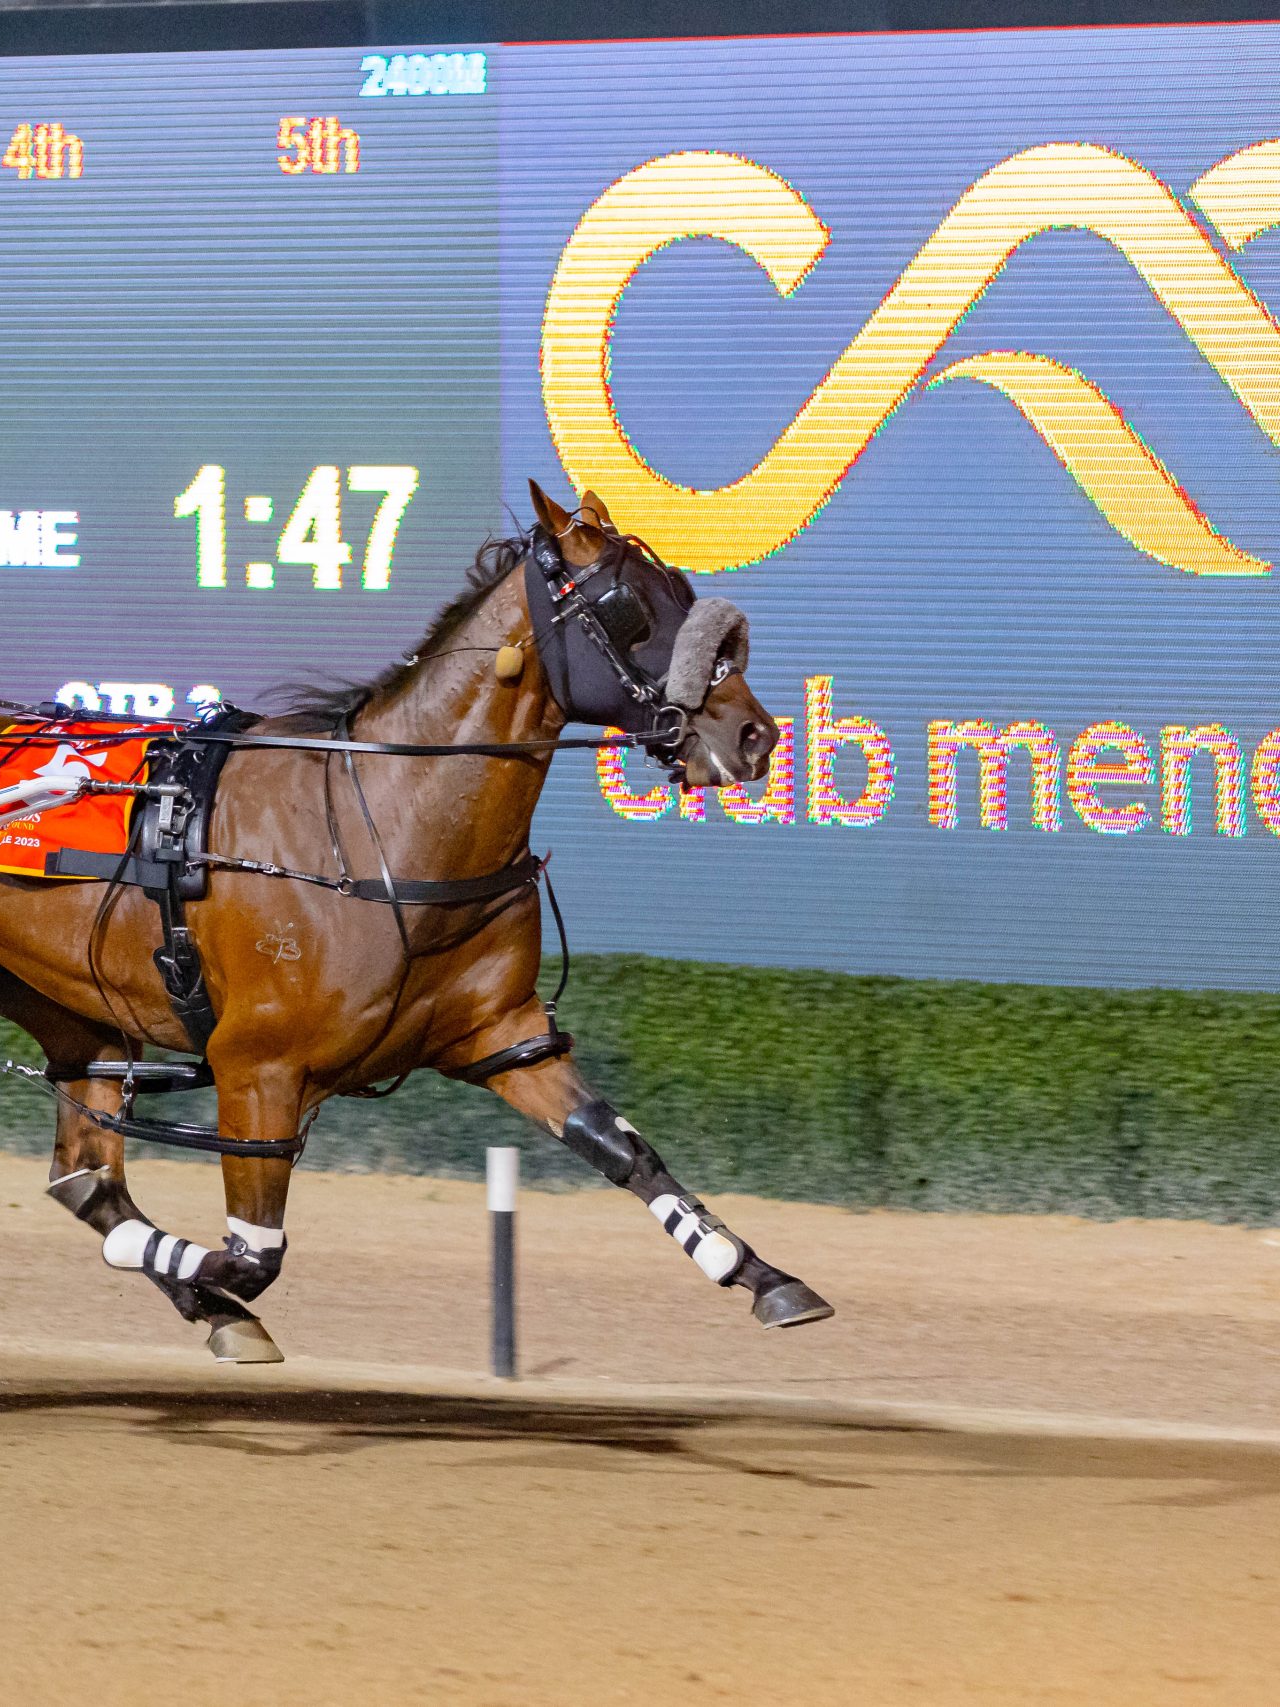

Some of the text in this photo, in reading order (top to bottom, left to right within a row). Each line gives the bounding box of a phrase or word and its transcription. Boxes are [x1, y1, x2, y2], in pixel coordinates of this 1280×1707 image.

[1, 122, 84, 179] 4th
[277, 116, 360, 175] 5th
[174, 464, 419, 590] 1:47
[596, 675, 897, 828] cub
[14, 836, 40, 847] 2023
